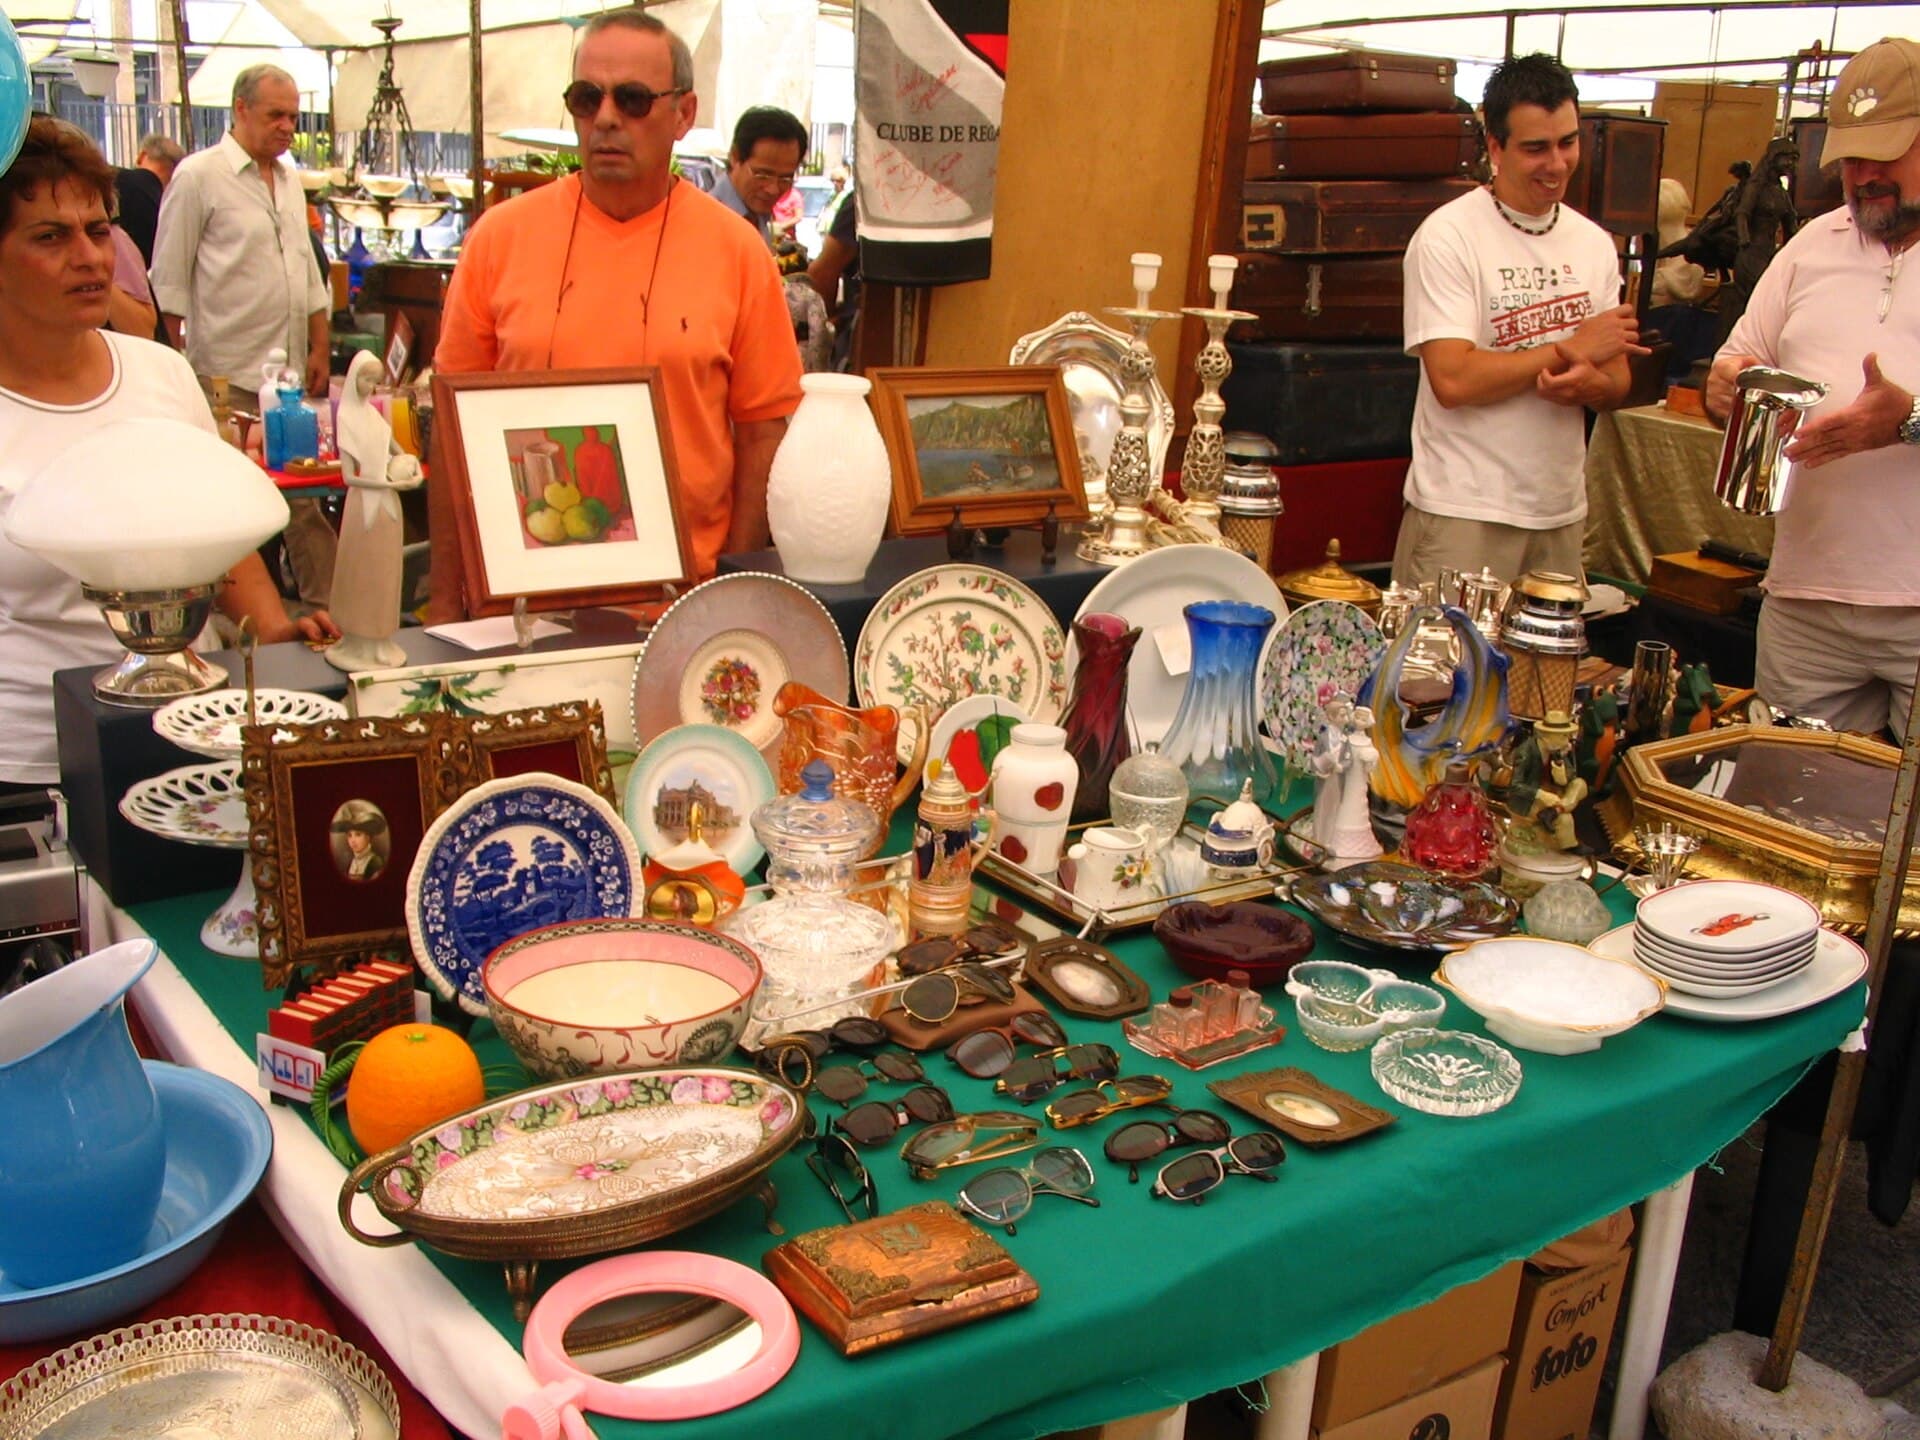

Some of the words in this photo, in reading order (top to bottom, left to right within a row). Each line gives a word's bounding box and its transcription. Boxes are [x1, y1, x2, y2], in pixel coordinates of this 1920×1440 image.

[876, 122, 933, 142] CLUBE
[939, 125, 964, 142] DE
[1544, 1282, 1608, 1332] Comfort
[1530, 1332, 1597, 1393] fofo
